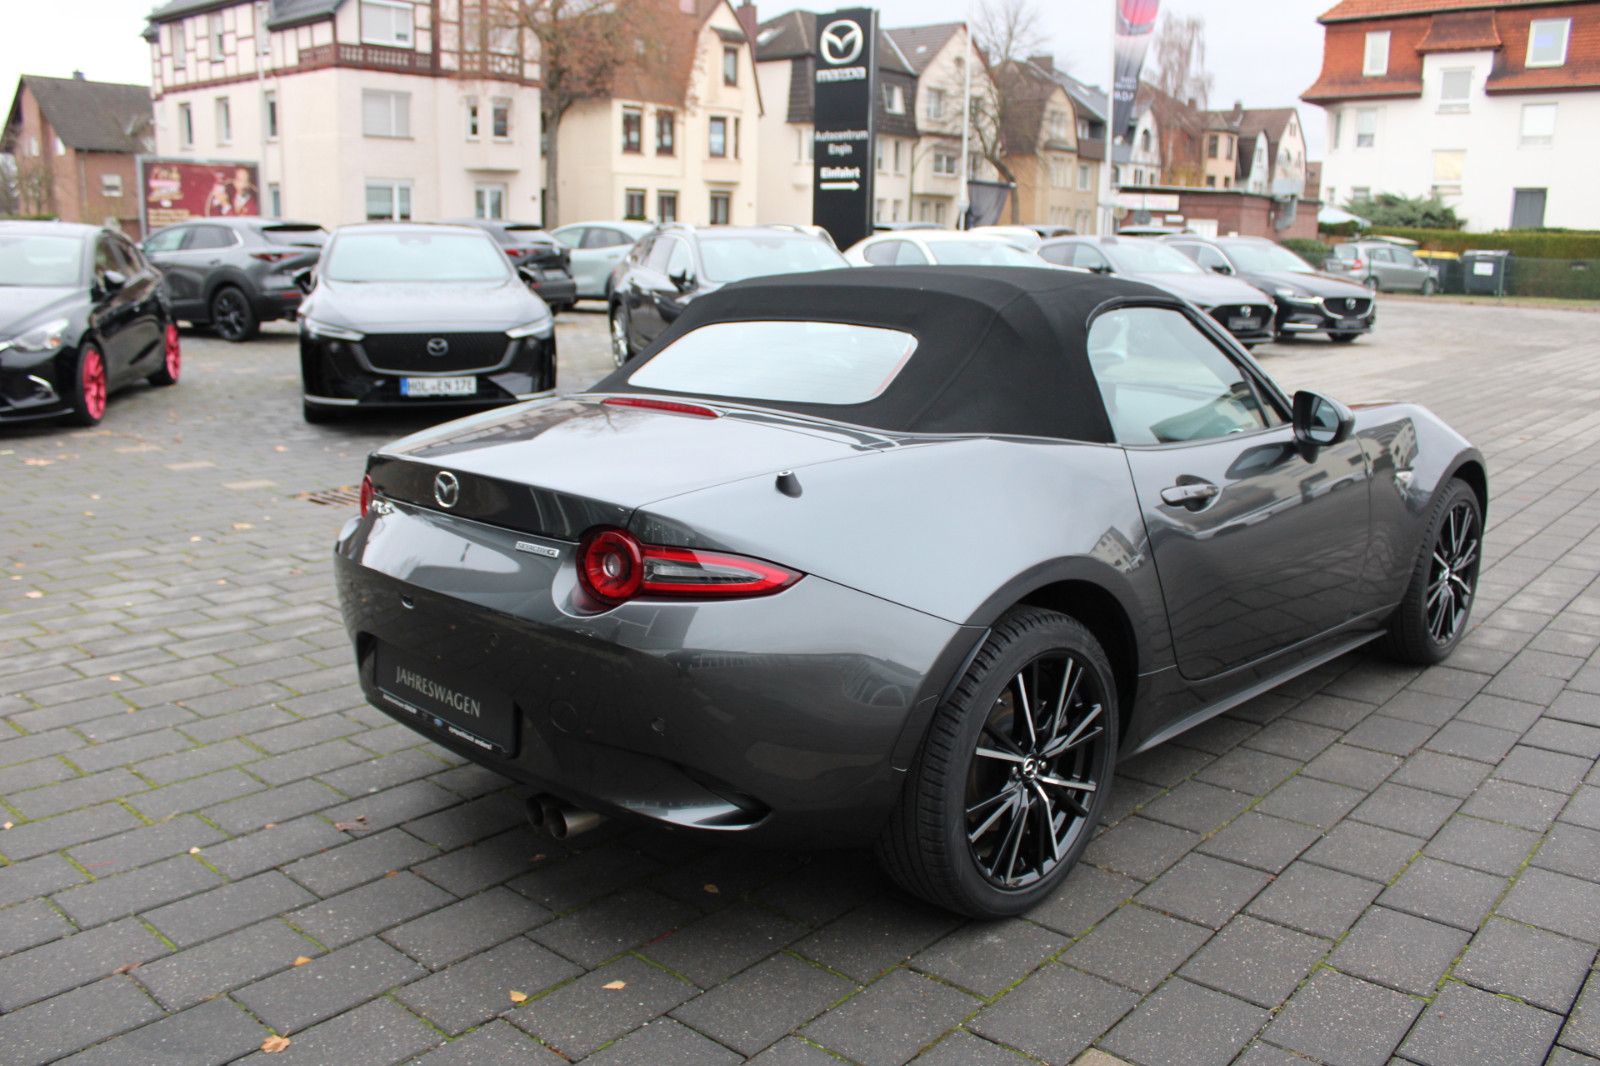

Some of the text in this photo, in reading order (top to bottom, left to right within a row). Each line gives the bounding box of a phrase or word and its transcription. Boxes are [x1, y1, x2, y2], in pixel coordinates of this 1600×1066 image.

[815, 131, 868, 142] Autocentrum
[828, 142, 853, 157] Engin
[820, 166, 860, 179] Einfahrt
[395, 666, 481, 718] JAHRESWAGEN
